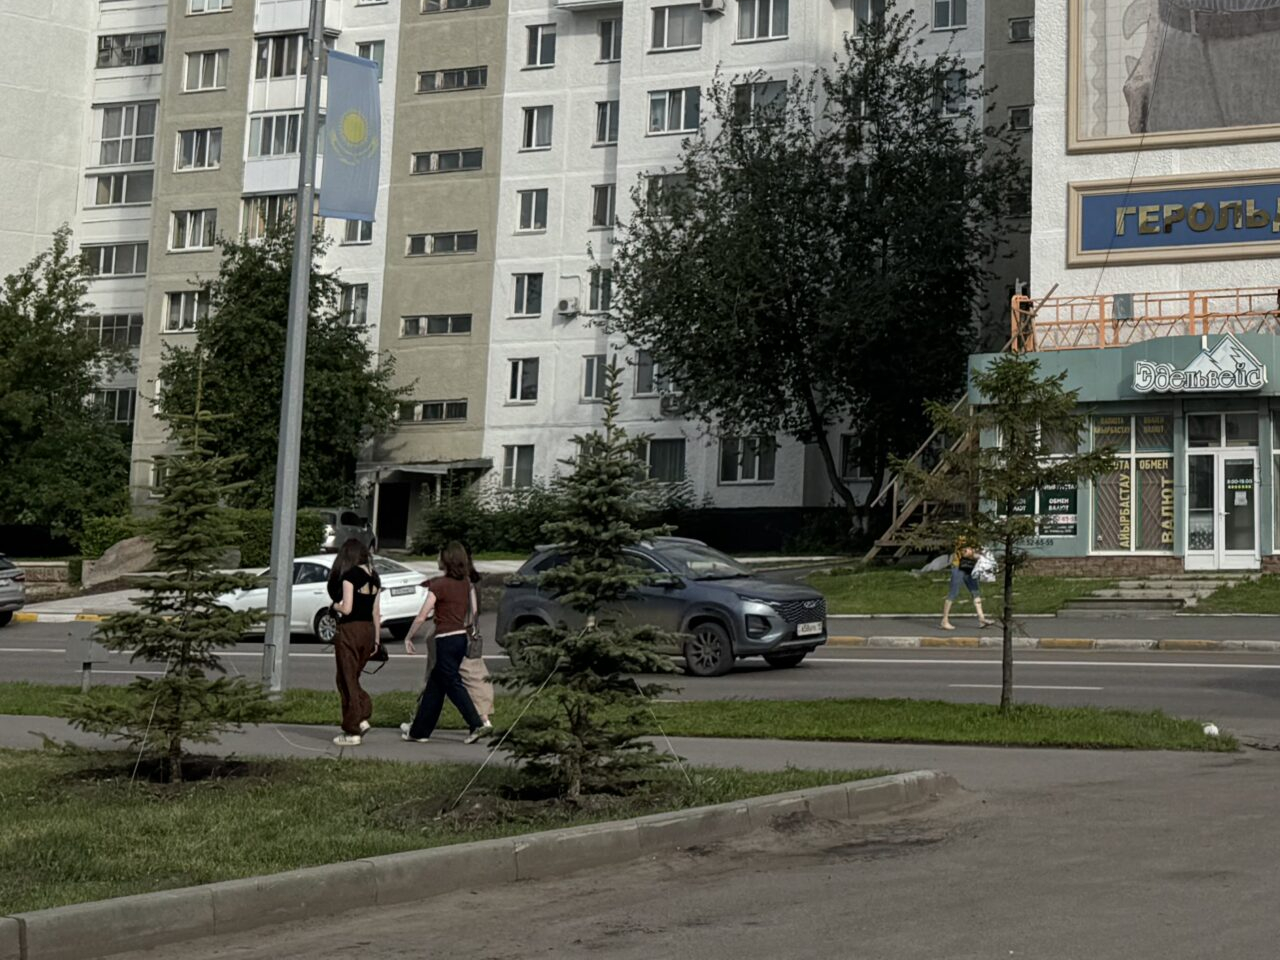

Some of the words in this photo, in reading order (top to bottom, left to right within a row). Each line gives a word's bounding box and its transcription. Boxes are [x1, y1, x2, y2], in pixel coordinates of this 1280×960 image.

[1135, 360, 1267, 391] Эдельвейс
[1139, 459, 1169, 470] ОБМЕН
[1161, 476, 1175, 544] ВАЛЮТ
